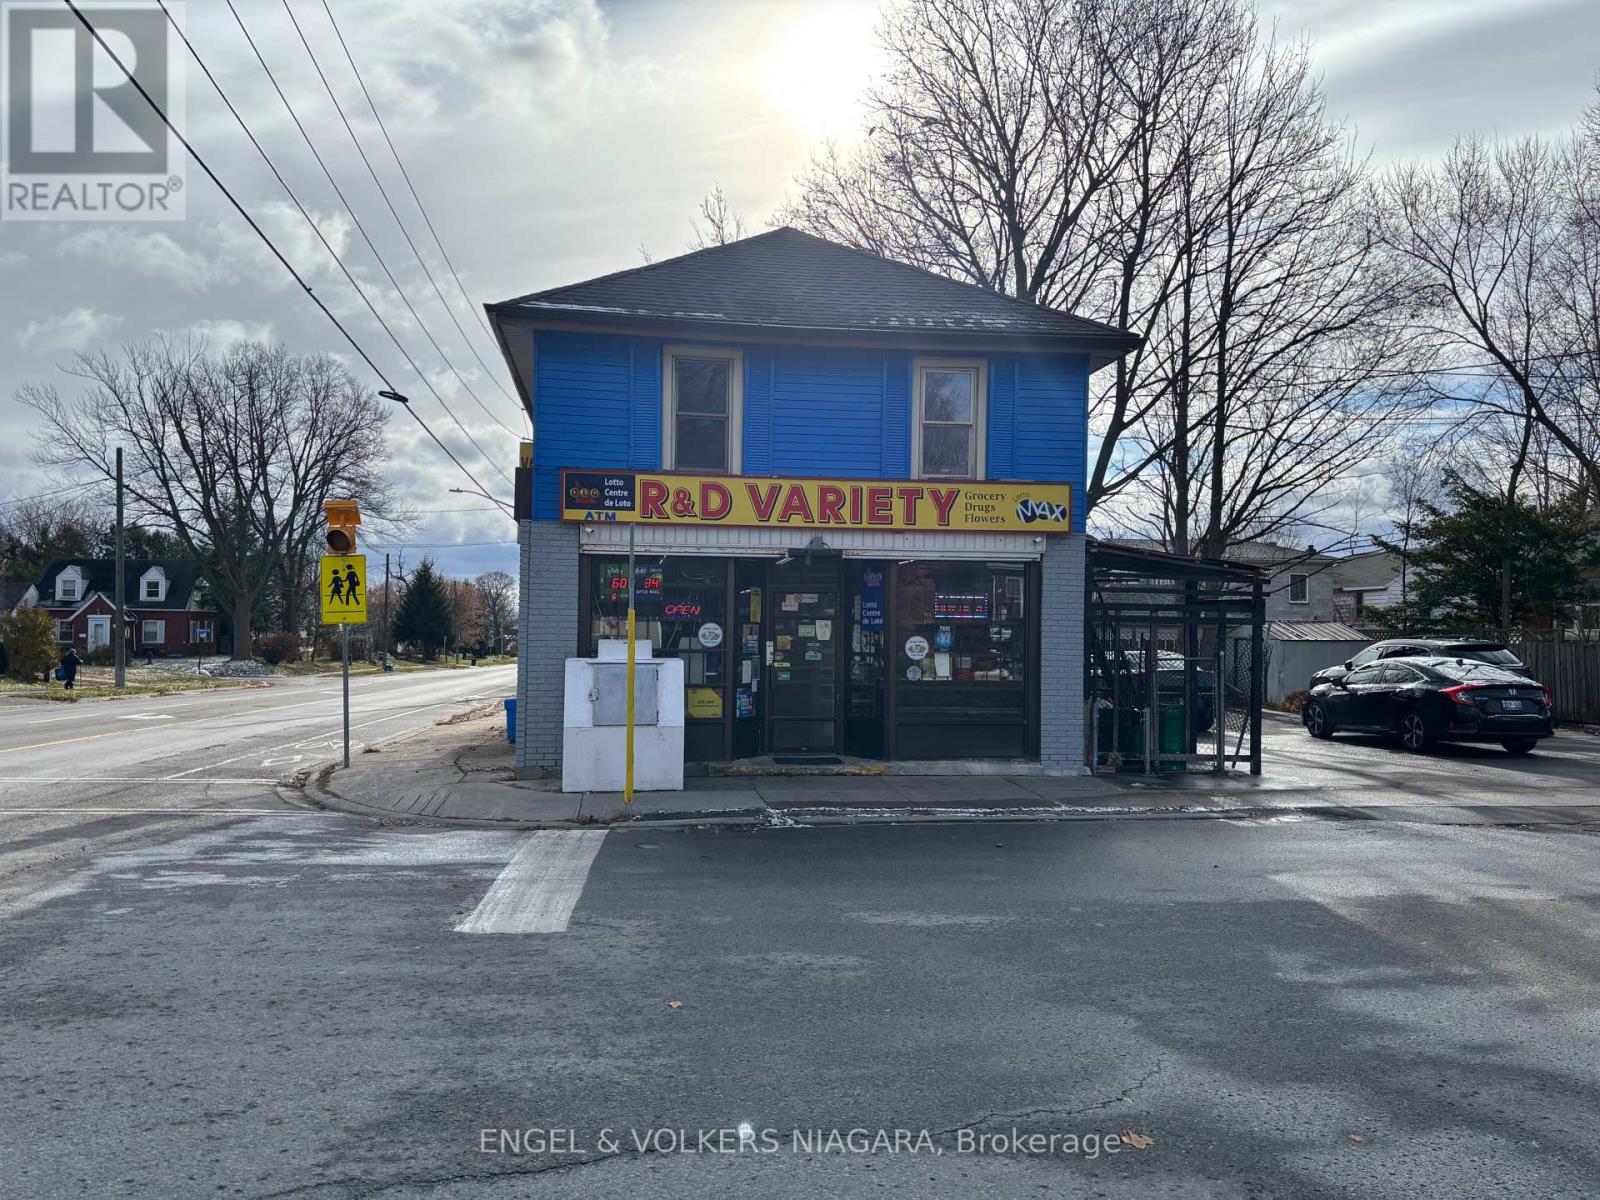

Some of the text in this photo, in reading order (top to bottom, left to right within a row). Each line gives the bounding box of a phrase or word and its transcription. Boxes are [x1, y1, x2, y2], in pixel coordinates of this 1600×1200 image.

[604, 477, 625, 486] Lotto
[604, 488, 629, 497] Centre
[964, 490, 1007, 502] Grocery
[604, 498, 632, 507] de Loto
[639, 478, 961, 527] R&D VARIETY
[964, 502, 996, 513] Drugs
[584, 511, 617, 521] ATM
[1017, 499, 1065, 524] MAX
[964, 514, 1006, 524] Flowers
[664, 604, 701, 616] OPEN
